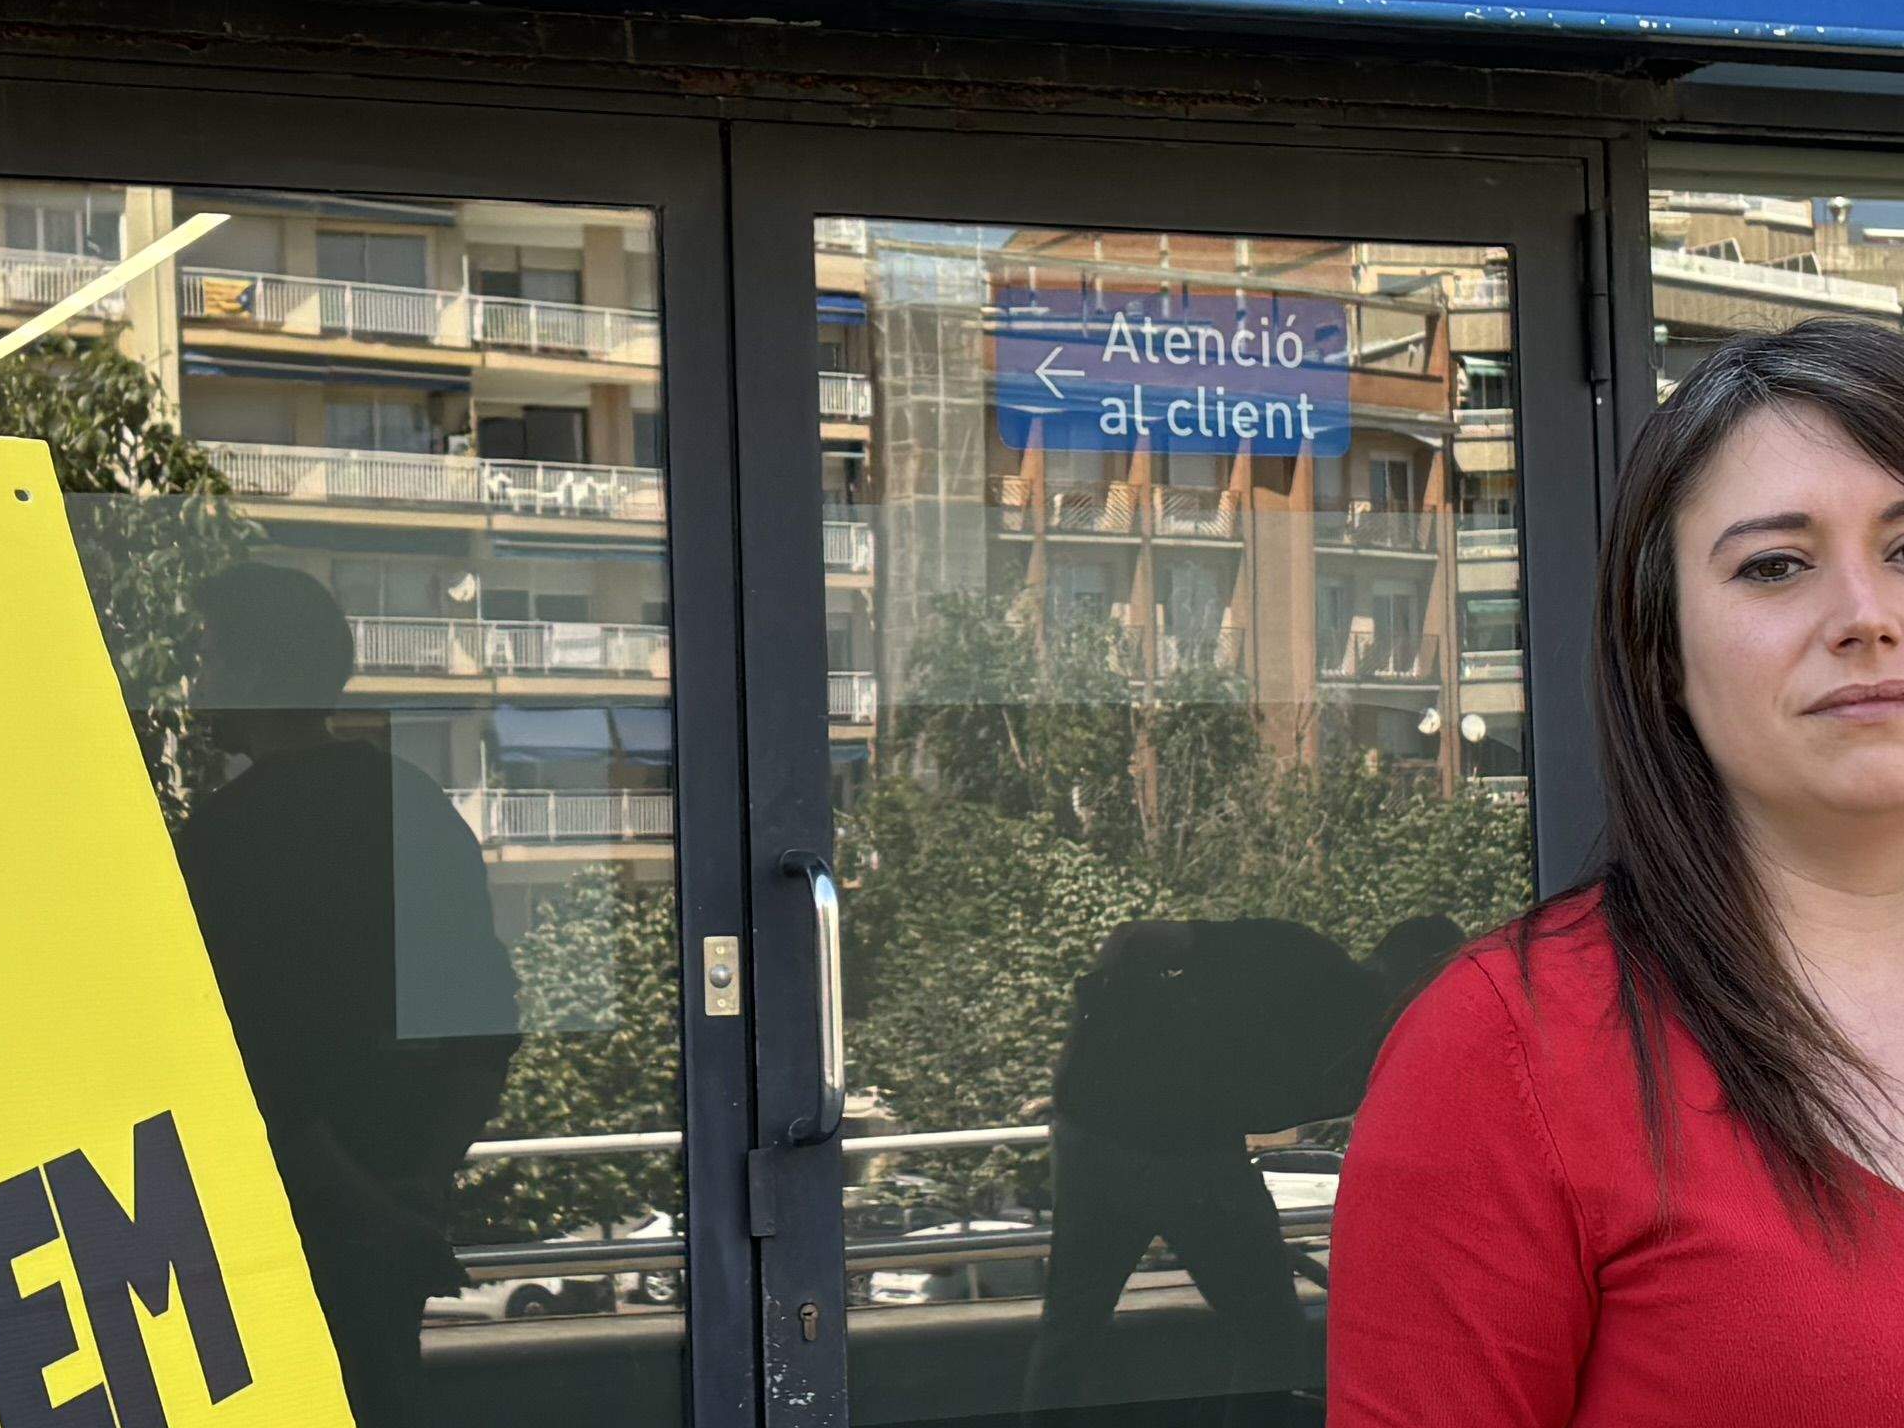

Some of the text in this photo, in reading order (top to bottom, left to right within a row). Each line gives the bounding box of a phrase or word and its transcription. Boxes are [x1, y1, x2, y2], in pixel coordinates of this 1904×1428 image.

[1101, 311, 1305, 369] Atenció
[1099, 384, 1315, 440] al client
